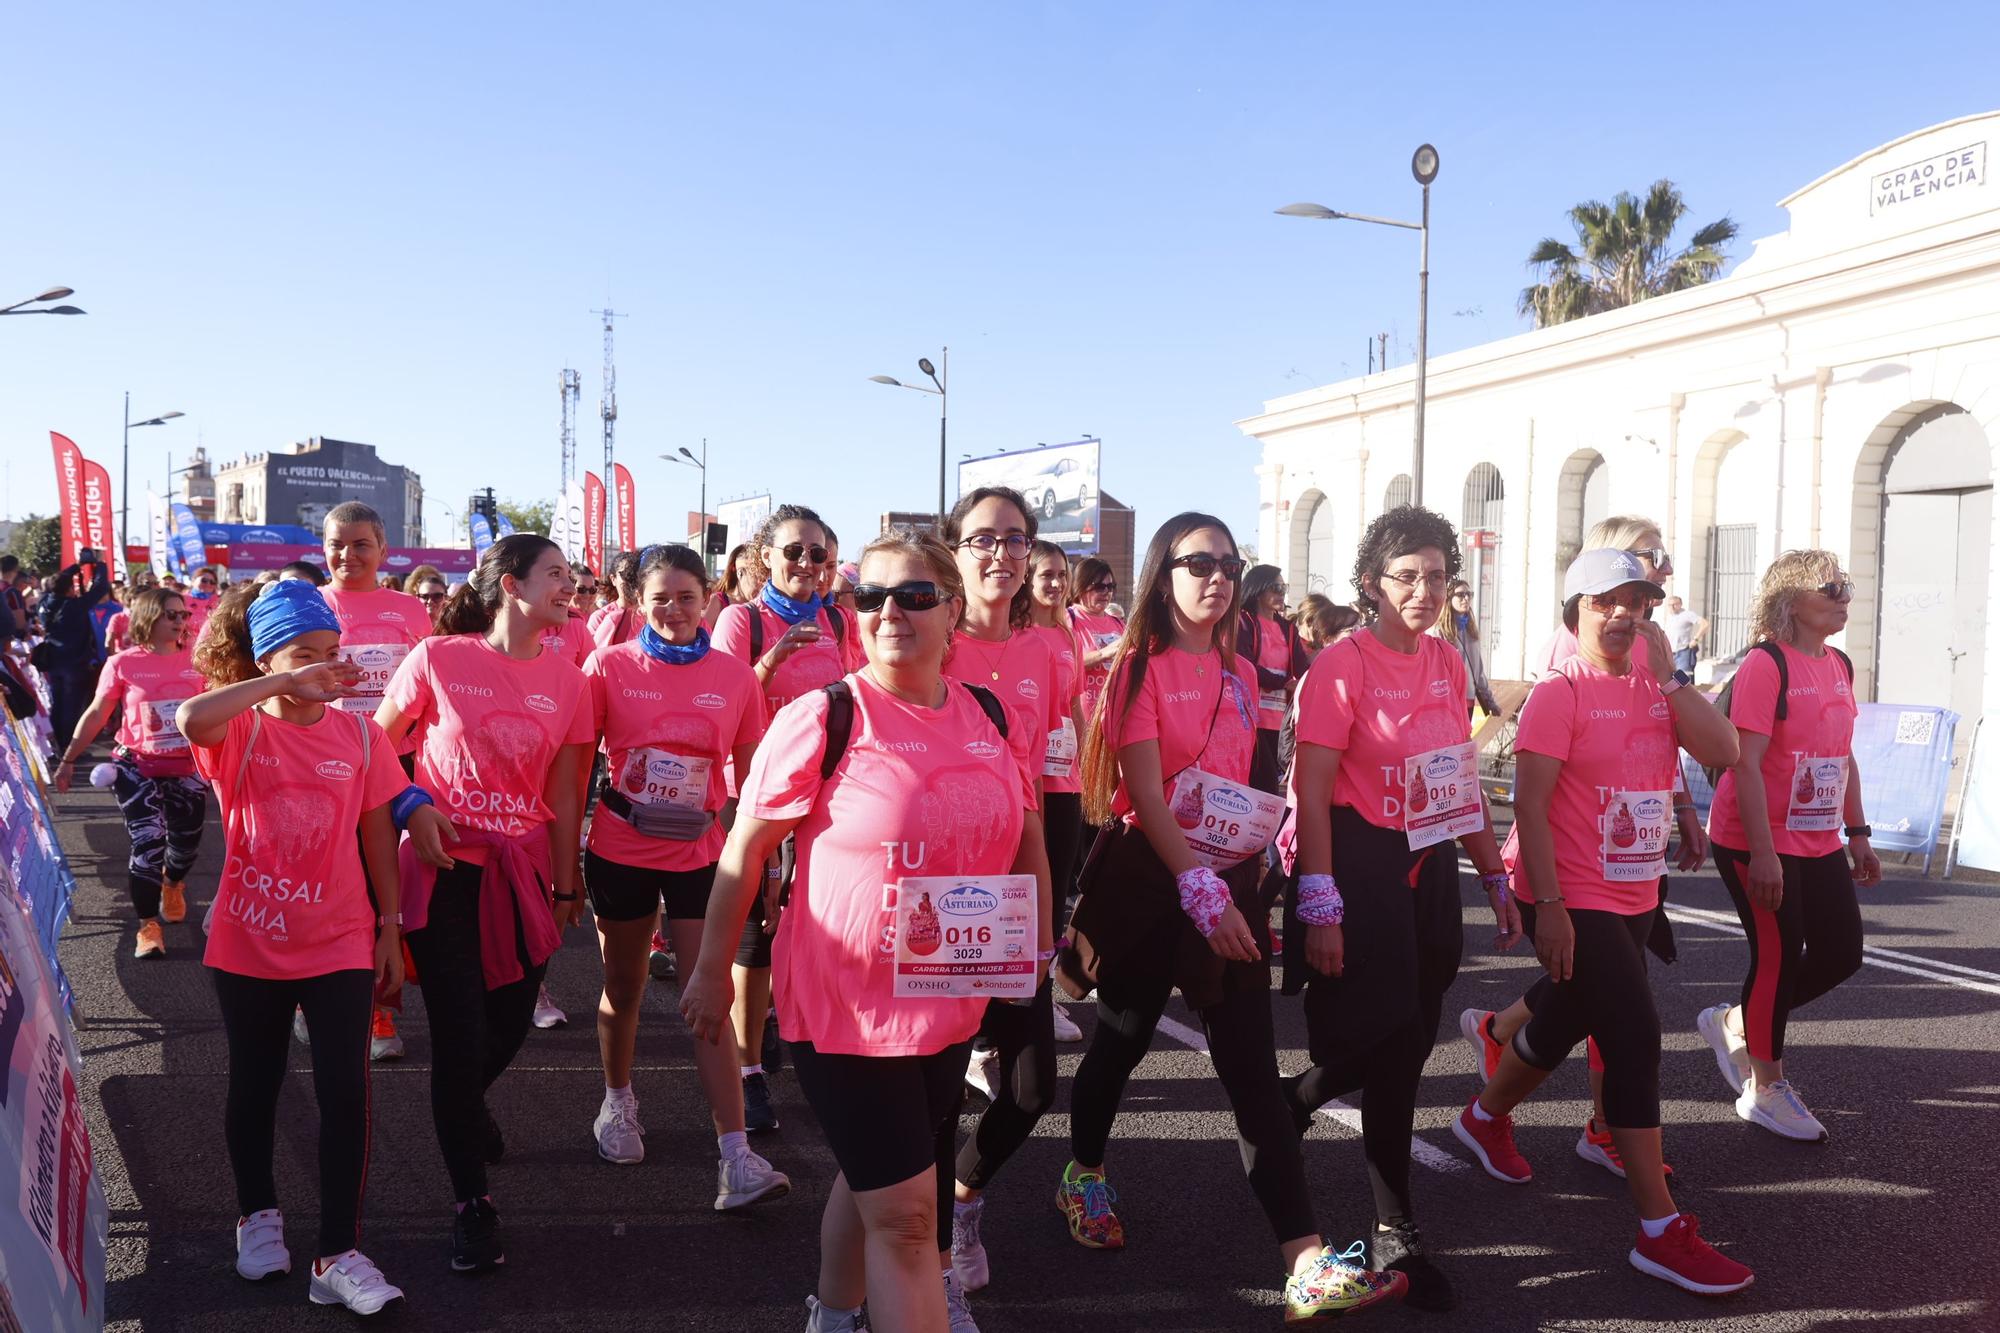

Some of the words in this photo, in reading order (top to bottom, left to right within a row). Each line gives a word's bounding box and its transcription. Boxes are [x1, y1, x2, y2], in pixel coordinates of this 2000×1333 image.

[1881, 164, 1934, 190] GRAO
[1945, 151, 1974, 171] DE
[1877, 168, 1977, 208] VALENCIA
[278, 467, 288, 476] EL
[290, 466, 325, 479] PUERTO
[449, 683, 493, 698] OYSHO
[622, 688, 662, 701] OYSHO
[1590, 709, 1627, 720] OYSHO
[874, 740, 928, 753] OYSHO
[1427, 764, 1456, 775] ASTURIANA
[647, 782, 679, 798] 016
[1430, 783, 1457, 800] 016
[1816, 786, 1836, 798] 016
[448, 788, 539, 812] DORSAL
[1209, 793, 1249, 813] ASTURIANA
[1204, 815, 1240, 836] 016
[1206, 832, 1229, 846] 3028
[1639, 826, 1661, 839] 016
[1644, 842, 1658, 850] 3521
[880, 841, 925, 870] TU
[1614, 867, 1644, 875] OYSHO
[1002, 892, 1027, 900] SUMA
[943, 897, 994, 909] ASTURIANA
[945, 926, 991, 945] 016
[954, 948, 983, 959] 3029
[907, 980, 951, 990] OYSHO
[984, 980, 1026, 989] Santander
